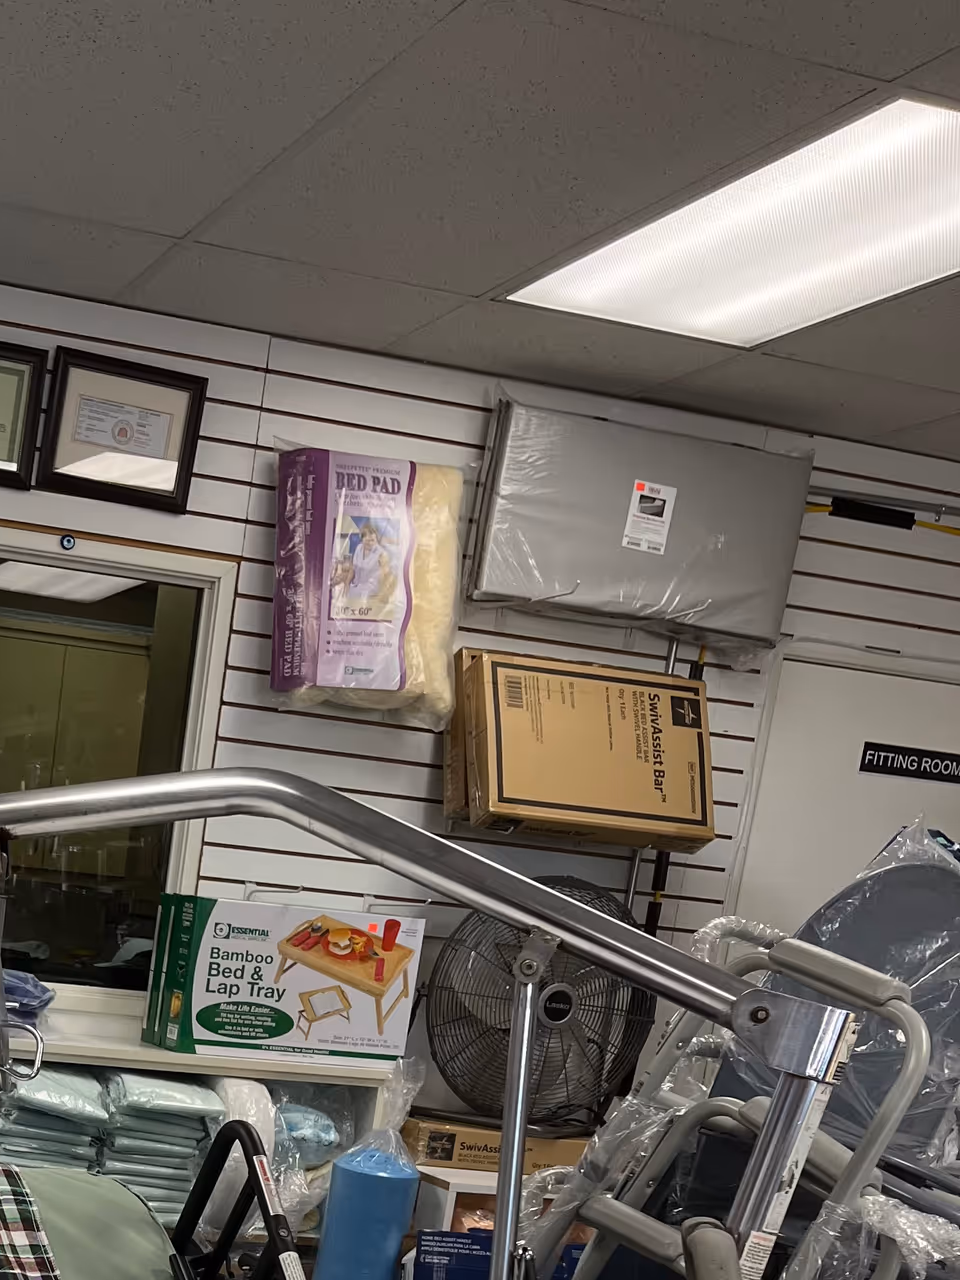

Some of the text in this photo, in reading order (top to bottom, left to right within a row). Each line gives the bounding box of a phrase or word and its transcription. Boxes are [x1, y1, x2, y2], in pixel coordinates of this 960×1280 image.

[335, 471, 401, 495] BED PAD
[284, 630, 292, 652] BED
[283, 654, 292, 677] PAD
[632, 708, 641, 732] SWIVEL
[648, 692, 666, 767] SwivAssist
[864, 750, 918, 770] FITTING
[232, 926, 270, 937] ESSENTIAL
[210, 946, 274, 965] Bamboo
[208, 962, 264, 982] Bed &
[205, 978, 286, 1002] Lap Tray
[238, 1004, 250, 1012] Life
[546, 1001, 570, 1010] Lasko
[460, 1141, 502, 1154] SwivAssi
